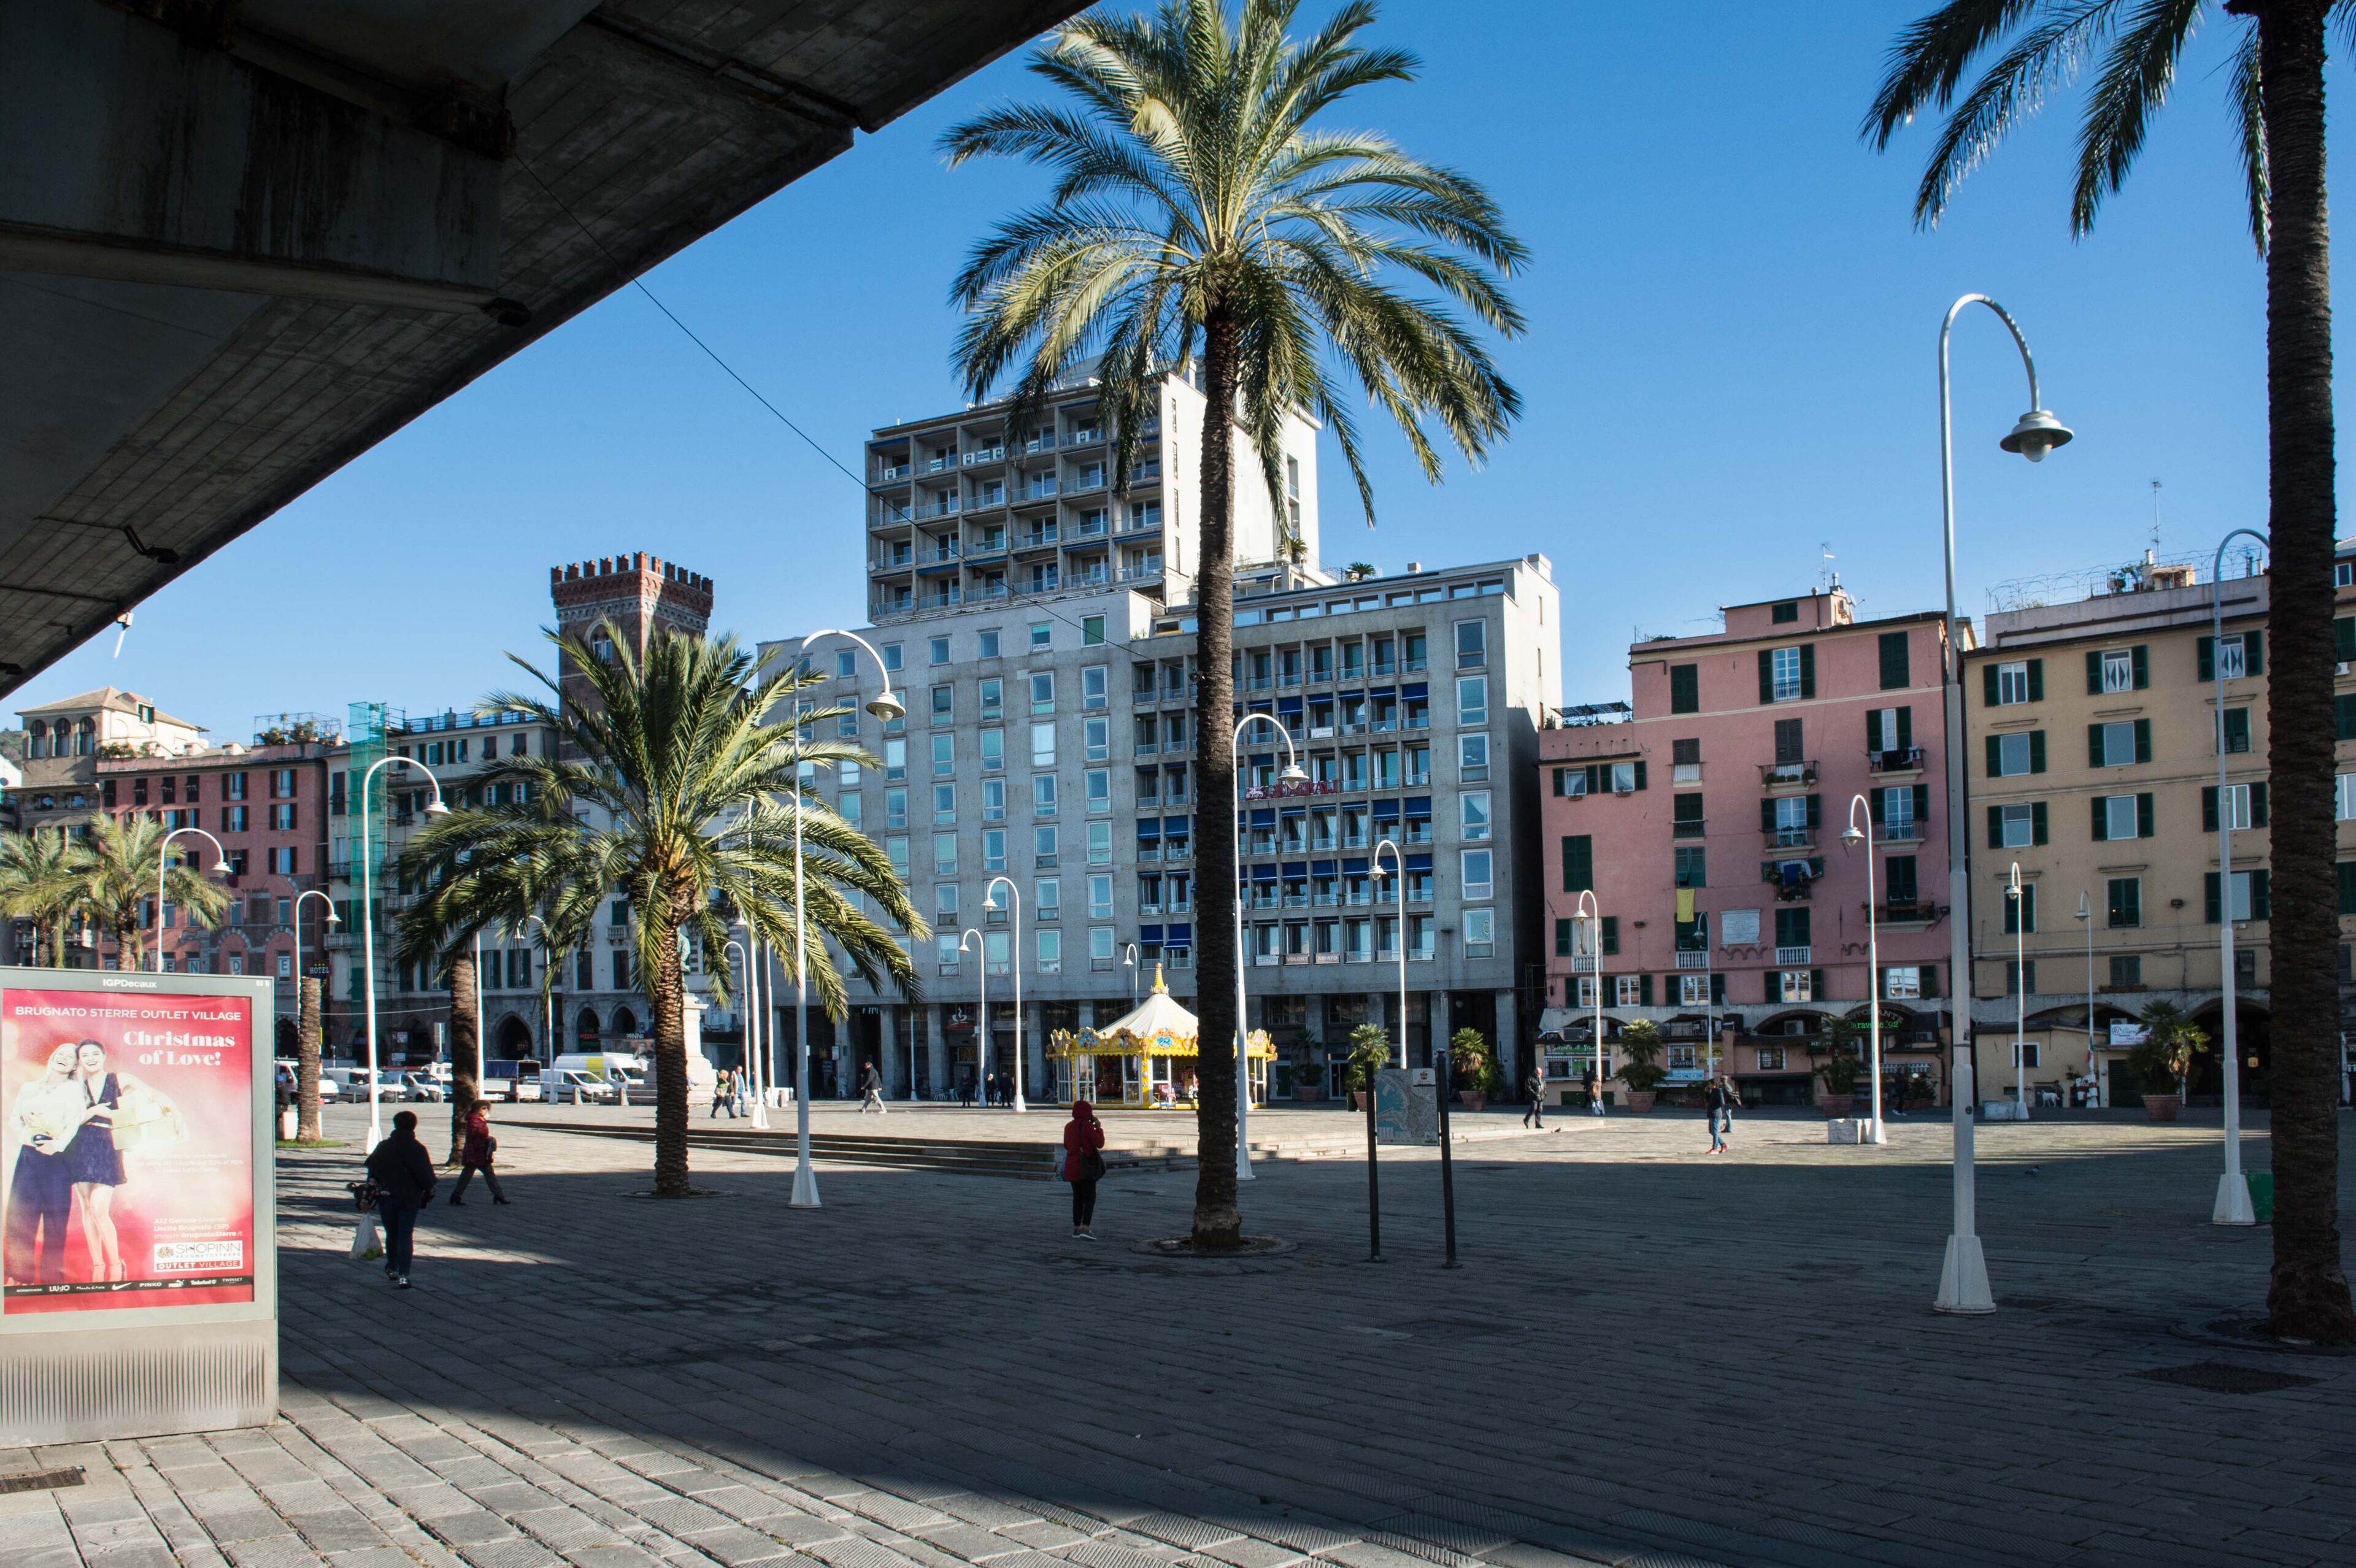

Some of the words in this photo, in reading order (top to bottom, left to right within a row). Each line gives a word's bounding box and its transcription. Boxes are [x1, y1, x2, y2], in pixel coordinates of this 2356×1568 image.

[102, 978, 157, 988] IGPDecaux
[15, 1006, 87, 1017] BRUGNATO
[141, 1010, 188, 1020] OUTLET
[191, 1011, 241, 1021] VILLAGE
[123, 1031, 235, 1047] Christmas
[139, 1050, 164, 1066] of
[167, 1051, 221, 1066] Love!
[175, 1243, 241, 1254] SHOPINN
